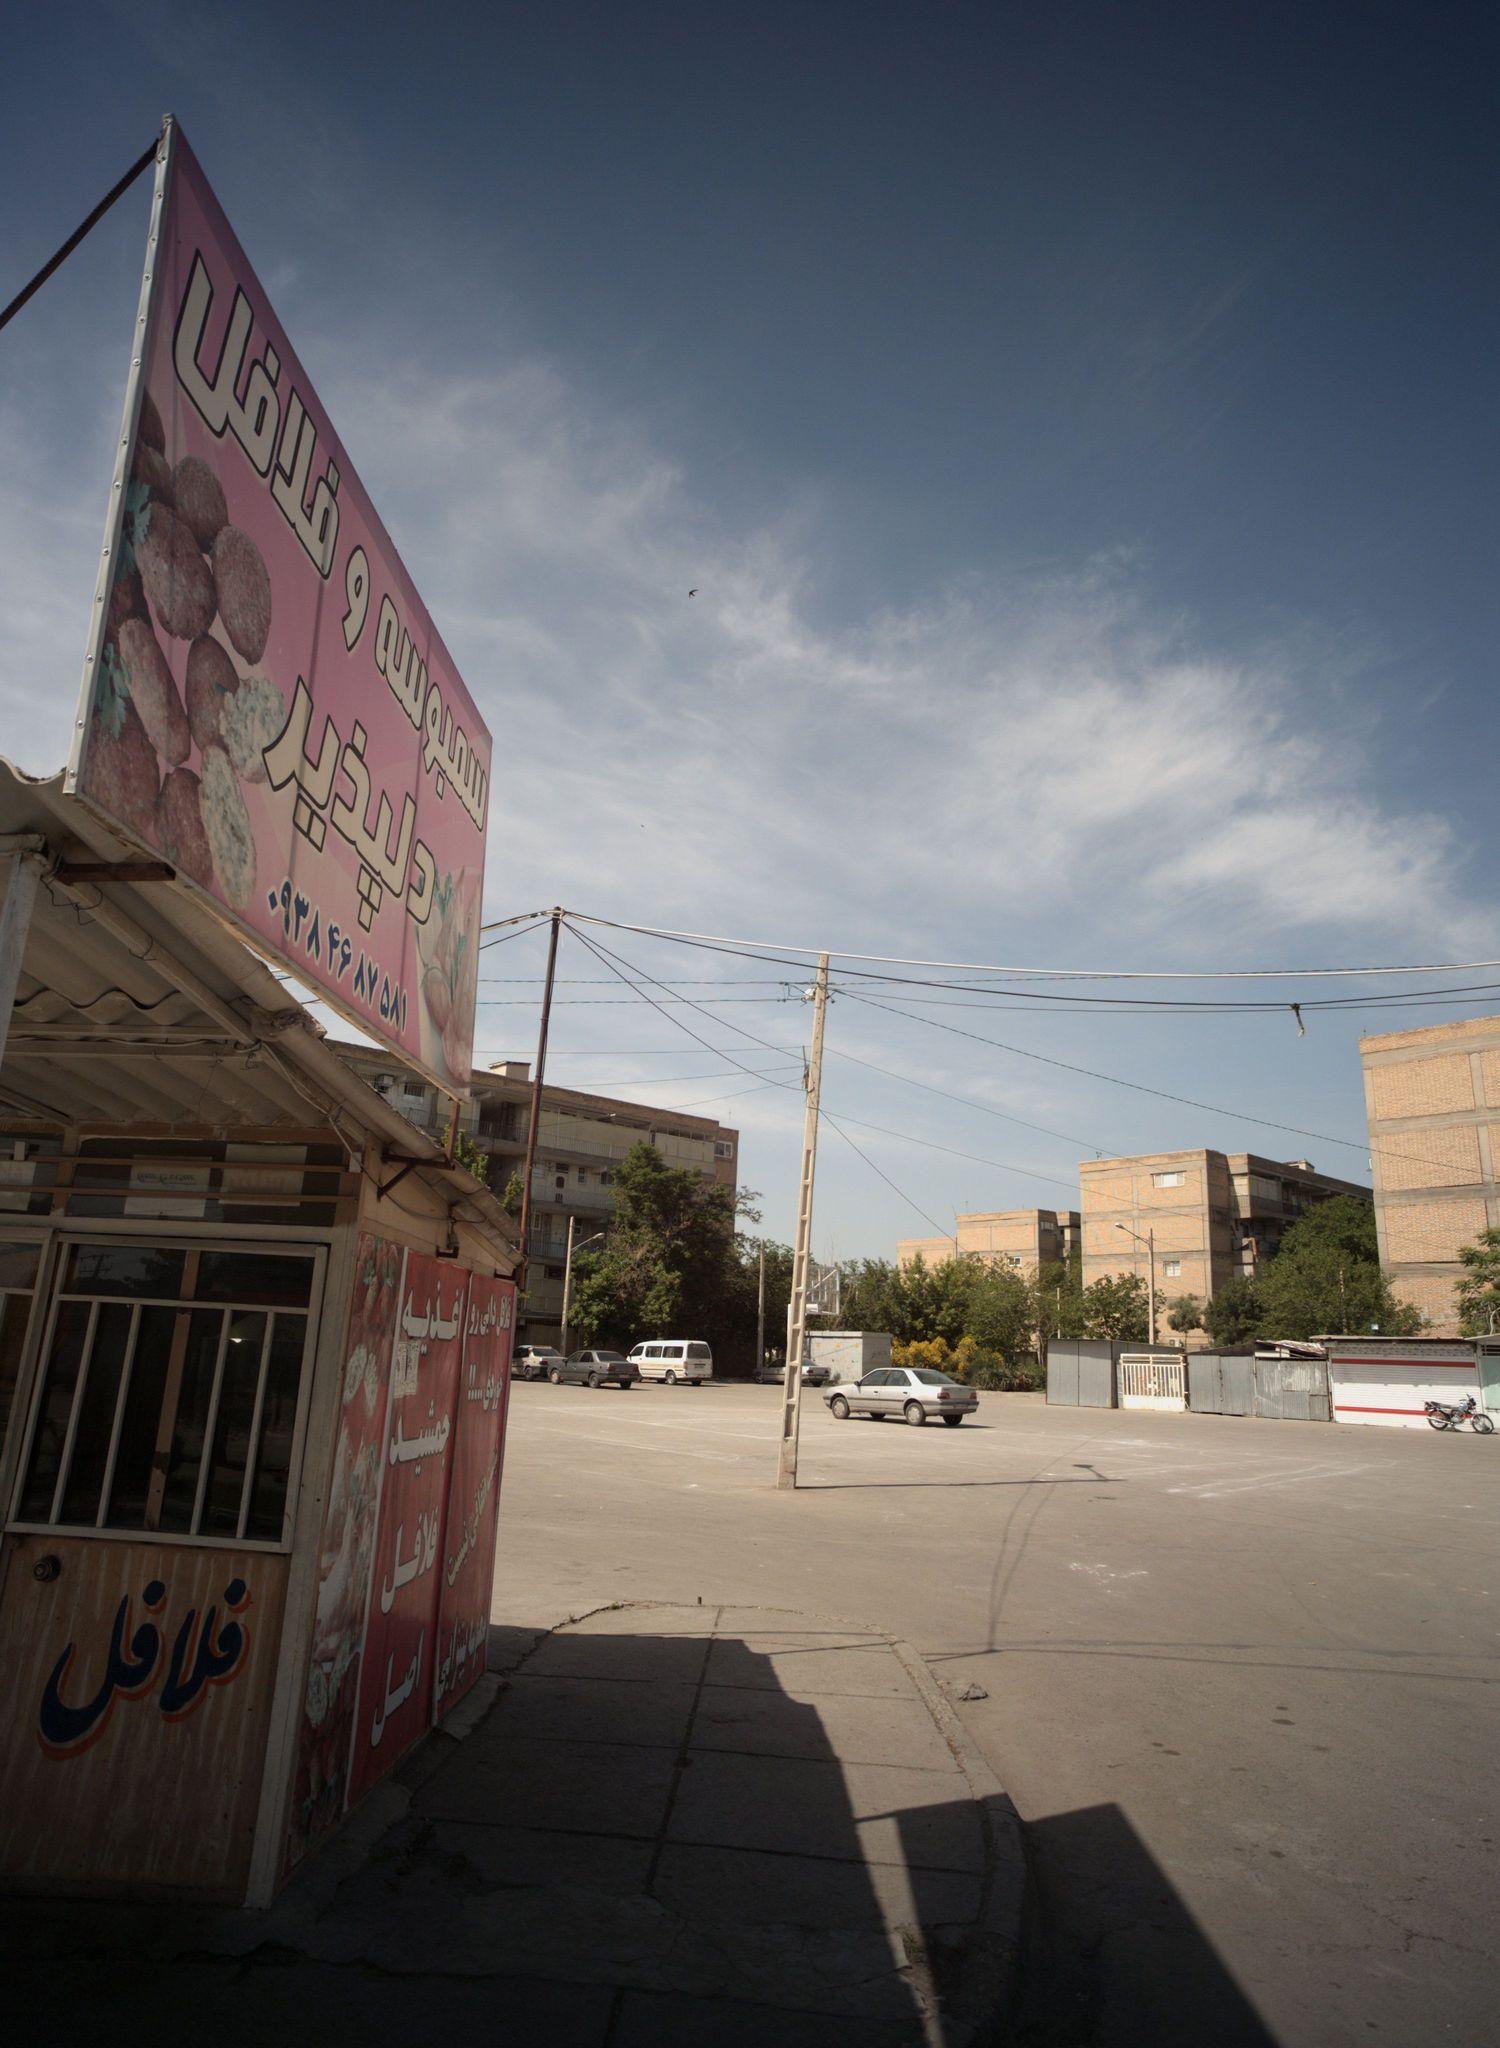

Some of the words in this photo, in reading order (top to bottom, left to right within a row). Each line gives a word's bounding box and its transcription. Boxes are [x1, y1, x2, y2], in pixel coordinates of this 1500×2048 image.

[172, 248, 341, 581] فلافل
[341, 545, 371, 653] و
[374, 593, 488, 833] سمبوسه
[262, 674, 437, 933] دلپذیر
[401, 1280, 465, 1355] اغذیه
[388, 1400, 451, 1477] جمشید
[381, 1507, 439, 1614] فلافل
[38, 1578, 250, 1761] فلافل
[370, 1628, 425, 1748] اصل
